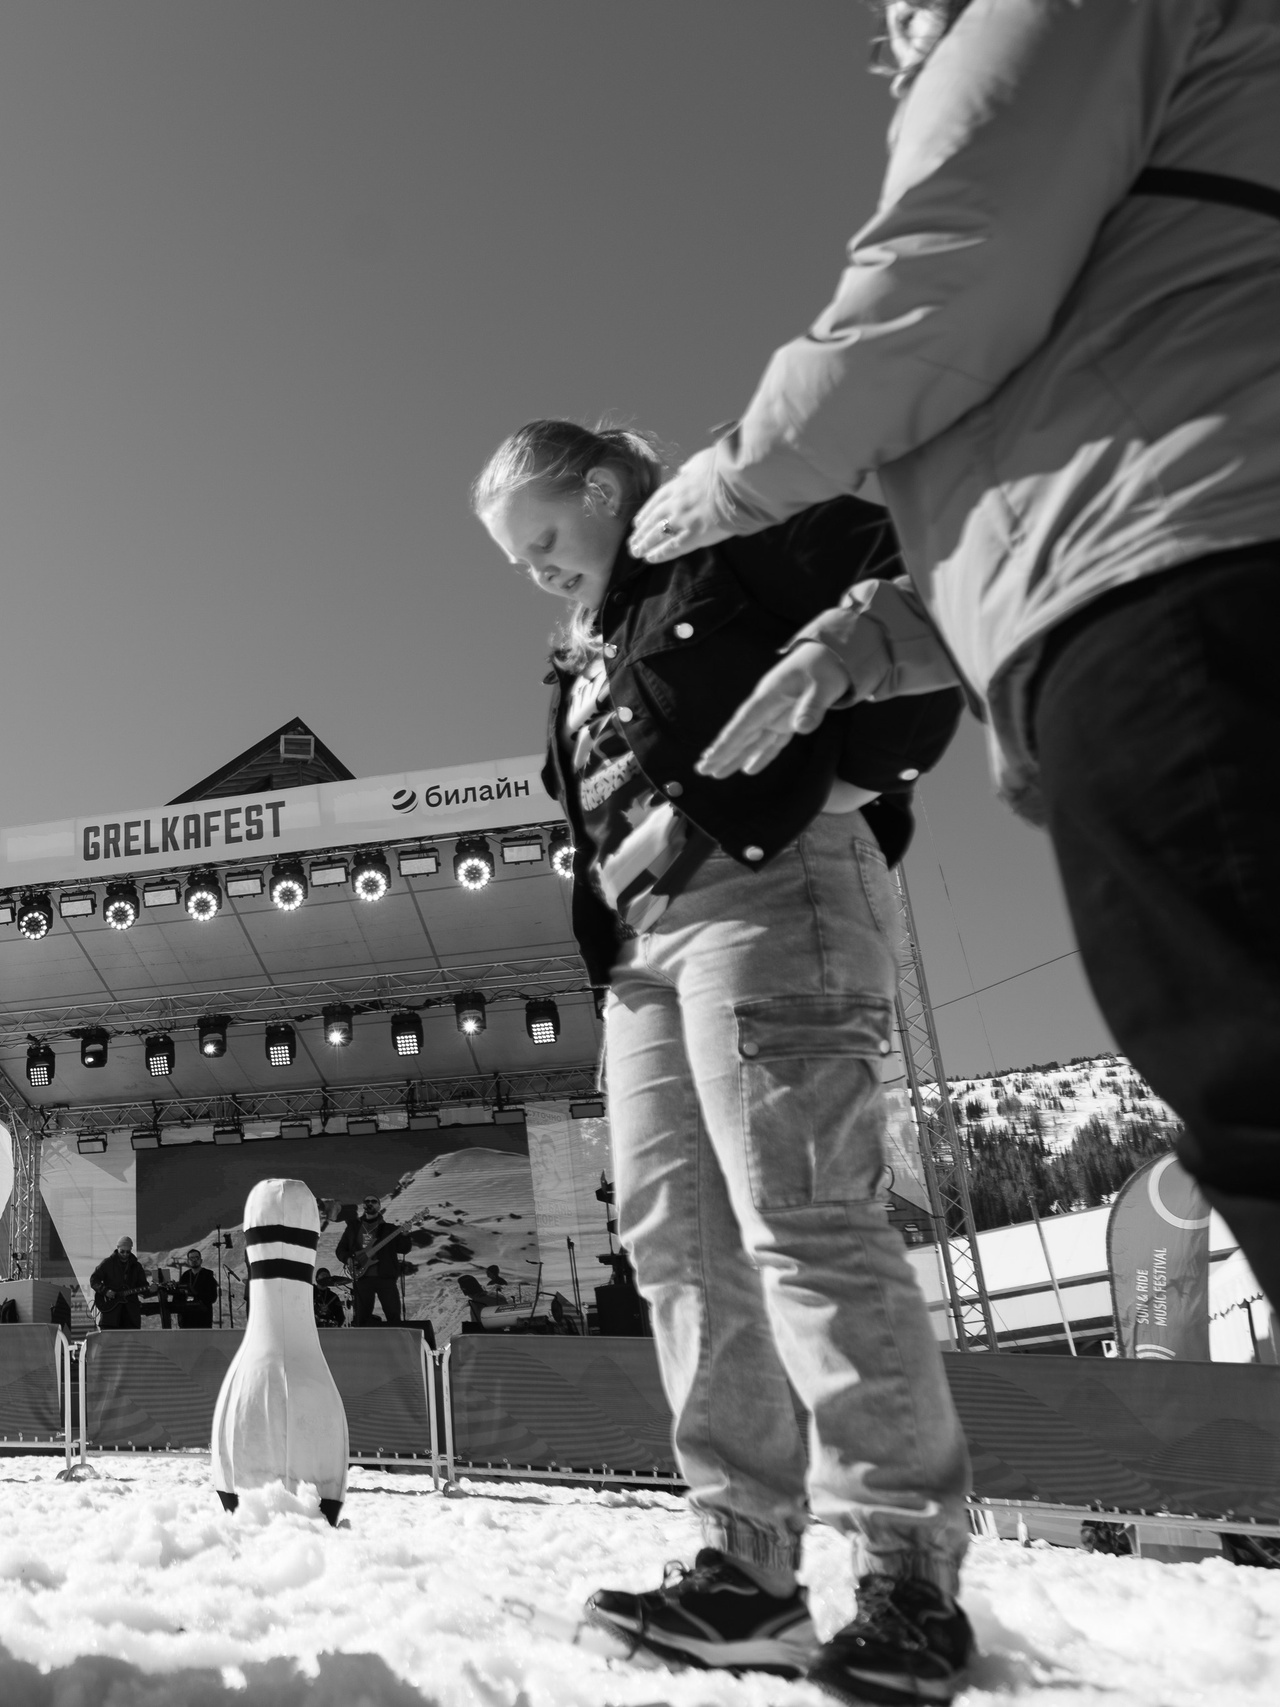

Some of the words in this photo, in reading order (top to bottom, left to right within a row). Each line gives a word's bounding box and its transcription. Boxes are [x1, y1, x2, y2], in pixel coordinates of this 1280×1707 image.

[425, 777, 529, 807] билайн
[83, 801, 286, 861] GRELKAFEST
[1136, 1269, 1149, 1292] RIDE
[1153, 1247, 1167, 1292] FESTIVAL
[1136, 1294, 1148, 1303] &
[1153, 1293, 1167, 1327] MUSIC
[1136, 1303, 1150, 1325] SUN
